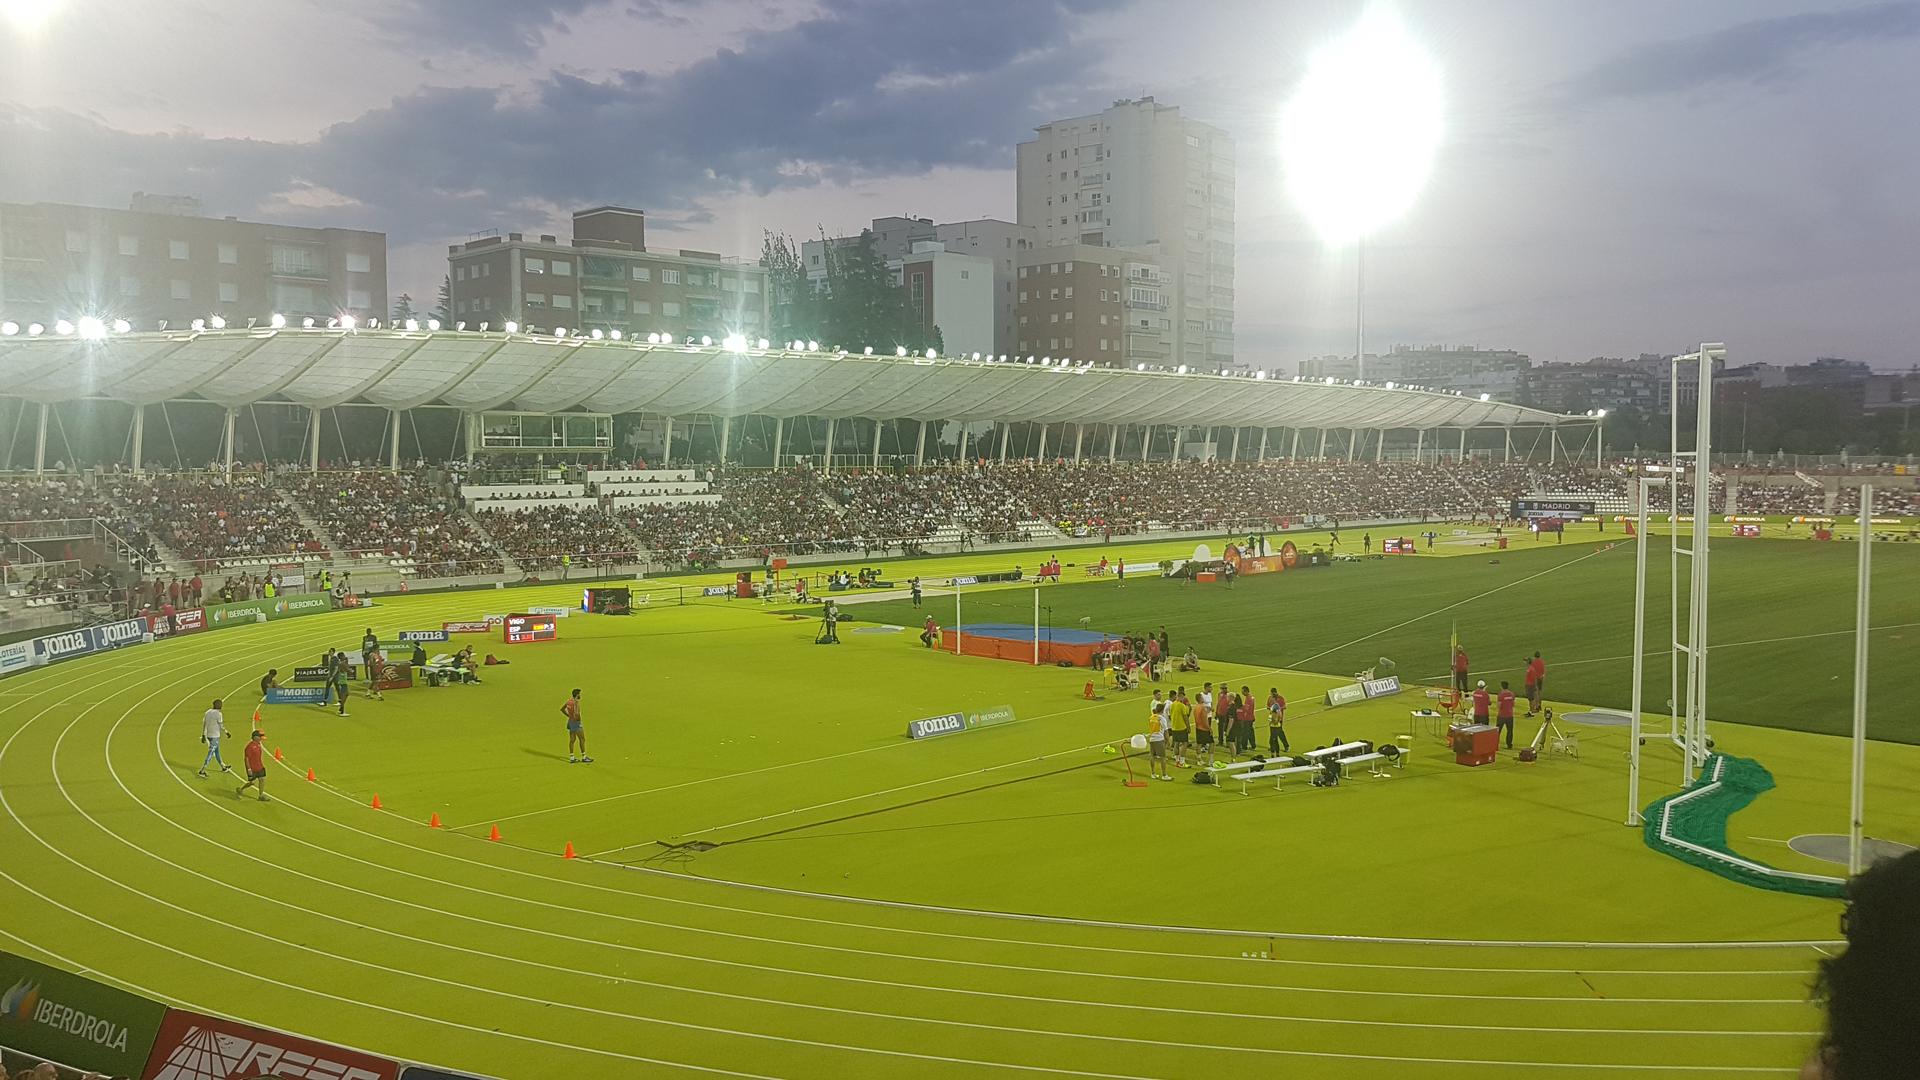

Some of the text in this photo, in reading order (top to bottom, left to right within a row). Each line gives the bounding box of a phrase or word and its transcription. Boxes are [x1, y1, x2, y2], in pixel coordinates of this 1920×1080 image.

[289, 599, 325, 609] IBERDROLA
[227, 607, 262, 618] IBERDROLA
[0, 644, 26, 659] OTERÍAS
[284, 688, 323, 697] MONDO
[980, 711, 1009, 721] IBERDROLA
[33, 998, 128, 1053] IBERDROLA
